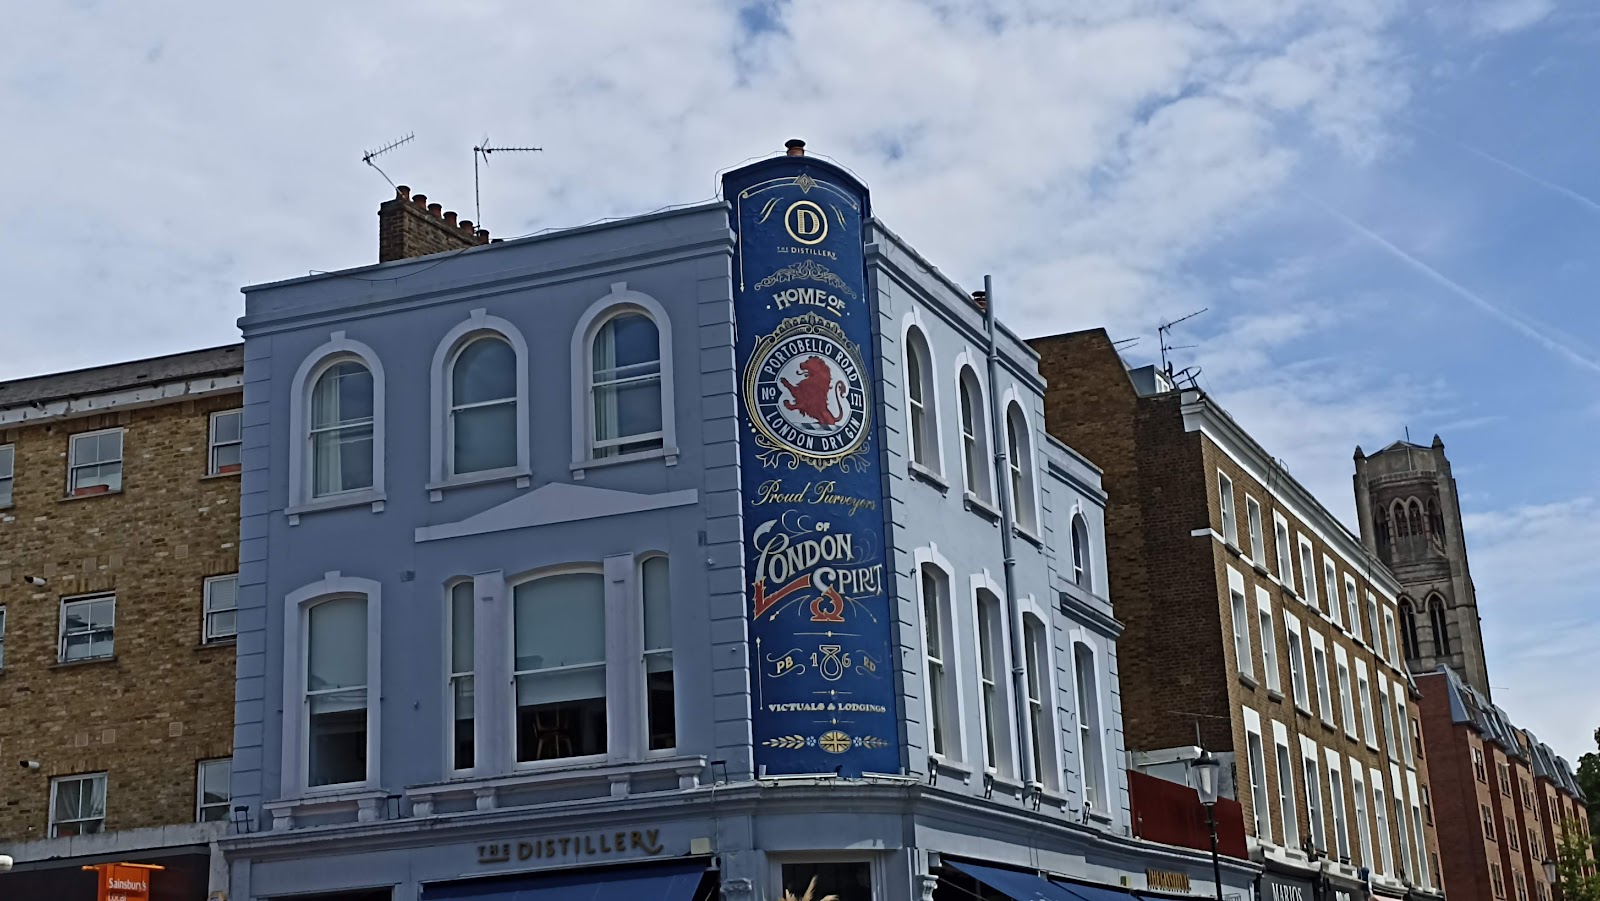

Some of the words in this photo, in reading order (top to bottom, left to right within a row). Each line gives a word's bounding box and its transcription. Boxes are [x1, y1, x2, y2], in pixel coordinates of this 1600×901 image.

[797, 209, 820, 235] D
[791, 247, 837, 260] DISTILLERY
[772, 287, 827, 310] HOME
[828, 295, 846, 310] OF
[764, 339, 833, 376] PORTOBELLO
[835, 352, 857, 382] ROAD
[851, 392, 862, 407] 171
[766, 411, 814, 449] LONDON
[821, 435, 844, 451] DRY
[845, 417, 861, 438] GIN
[751, 479, 811, 506] Proud
[808, 480, 876, 517] Purveyors
[815, 521, 831, 532] OF
[752, 519, 854, 621] LONDON
[810, 564, 884, 622] SPIRIT
[776, 656, 794, 674] PB
[863, 656, 876, 672] RD
[768, 702, 825, 712] VICTUALS
[827, 703, 836, 711] &
[838, 703, 886, 713] LODGINGS
[477, 843, 511, 859] THE
[516, 828, 664, 861] DISTILLERY
[109, 877, 147, 891] Sainsbury's
